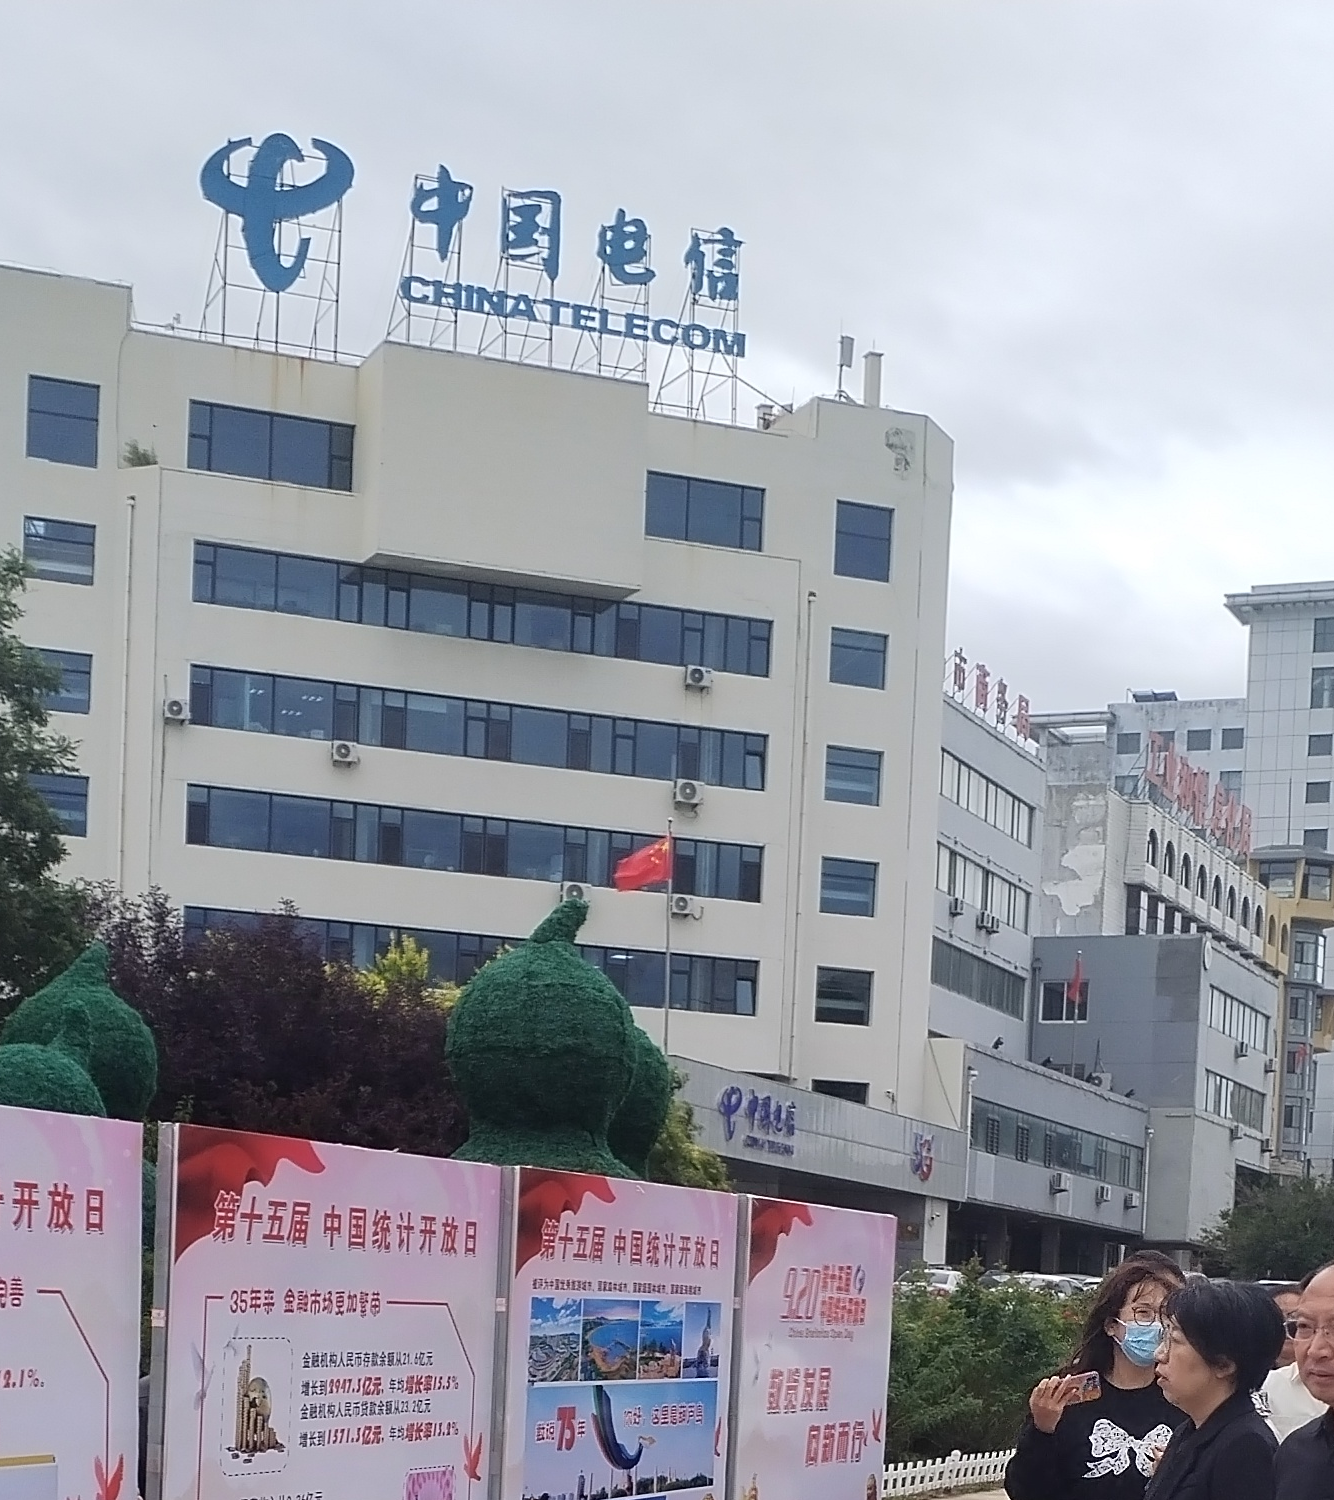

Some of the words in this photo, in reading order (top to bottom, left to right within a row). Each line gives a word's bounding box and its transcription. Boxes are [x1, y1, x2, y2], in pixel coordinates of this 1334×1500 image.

[409, 163, 748, 301] 中国电信
[211, 1189, 312, 1249] 第十五届
[323, 1203, 479, 1258] 中国统计开放日
[539, 1217, 607, 1265] 第十五届
[612, 1226, 721, 1272] 中国统计开放日
